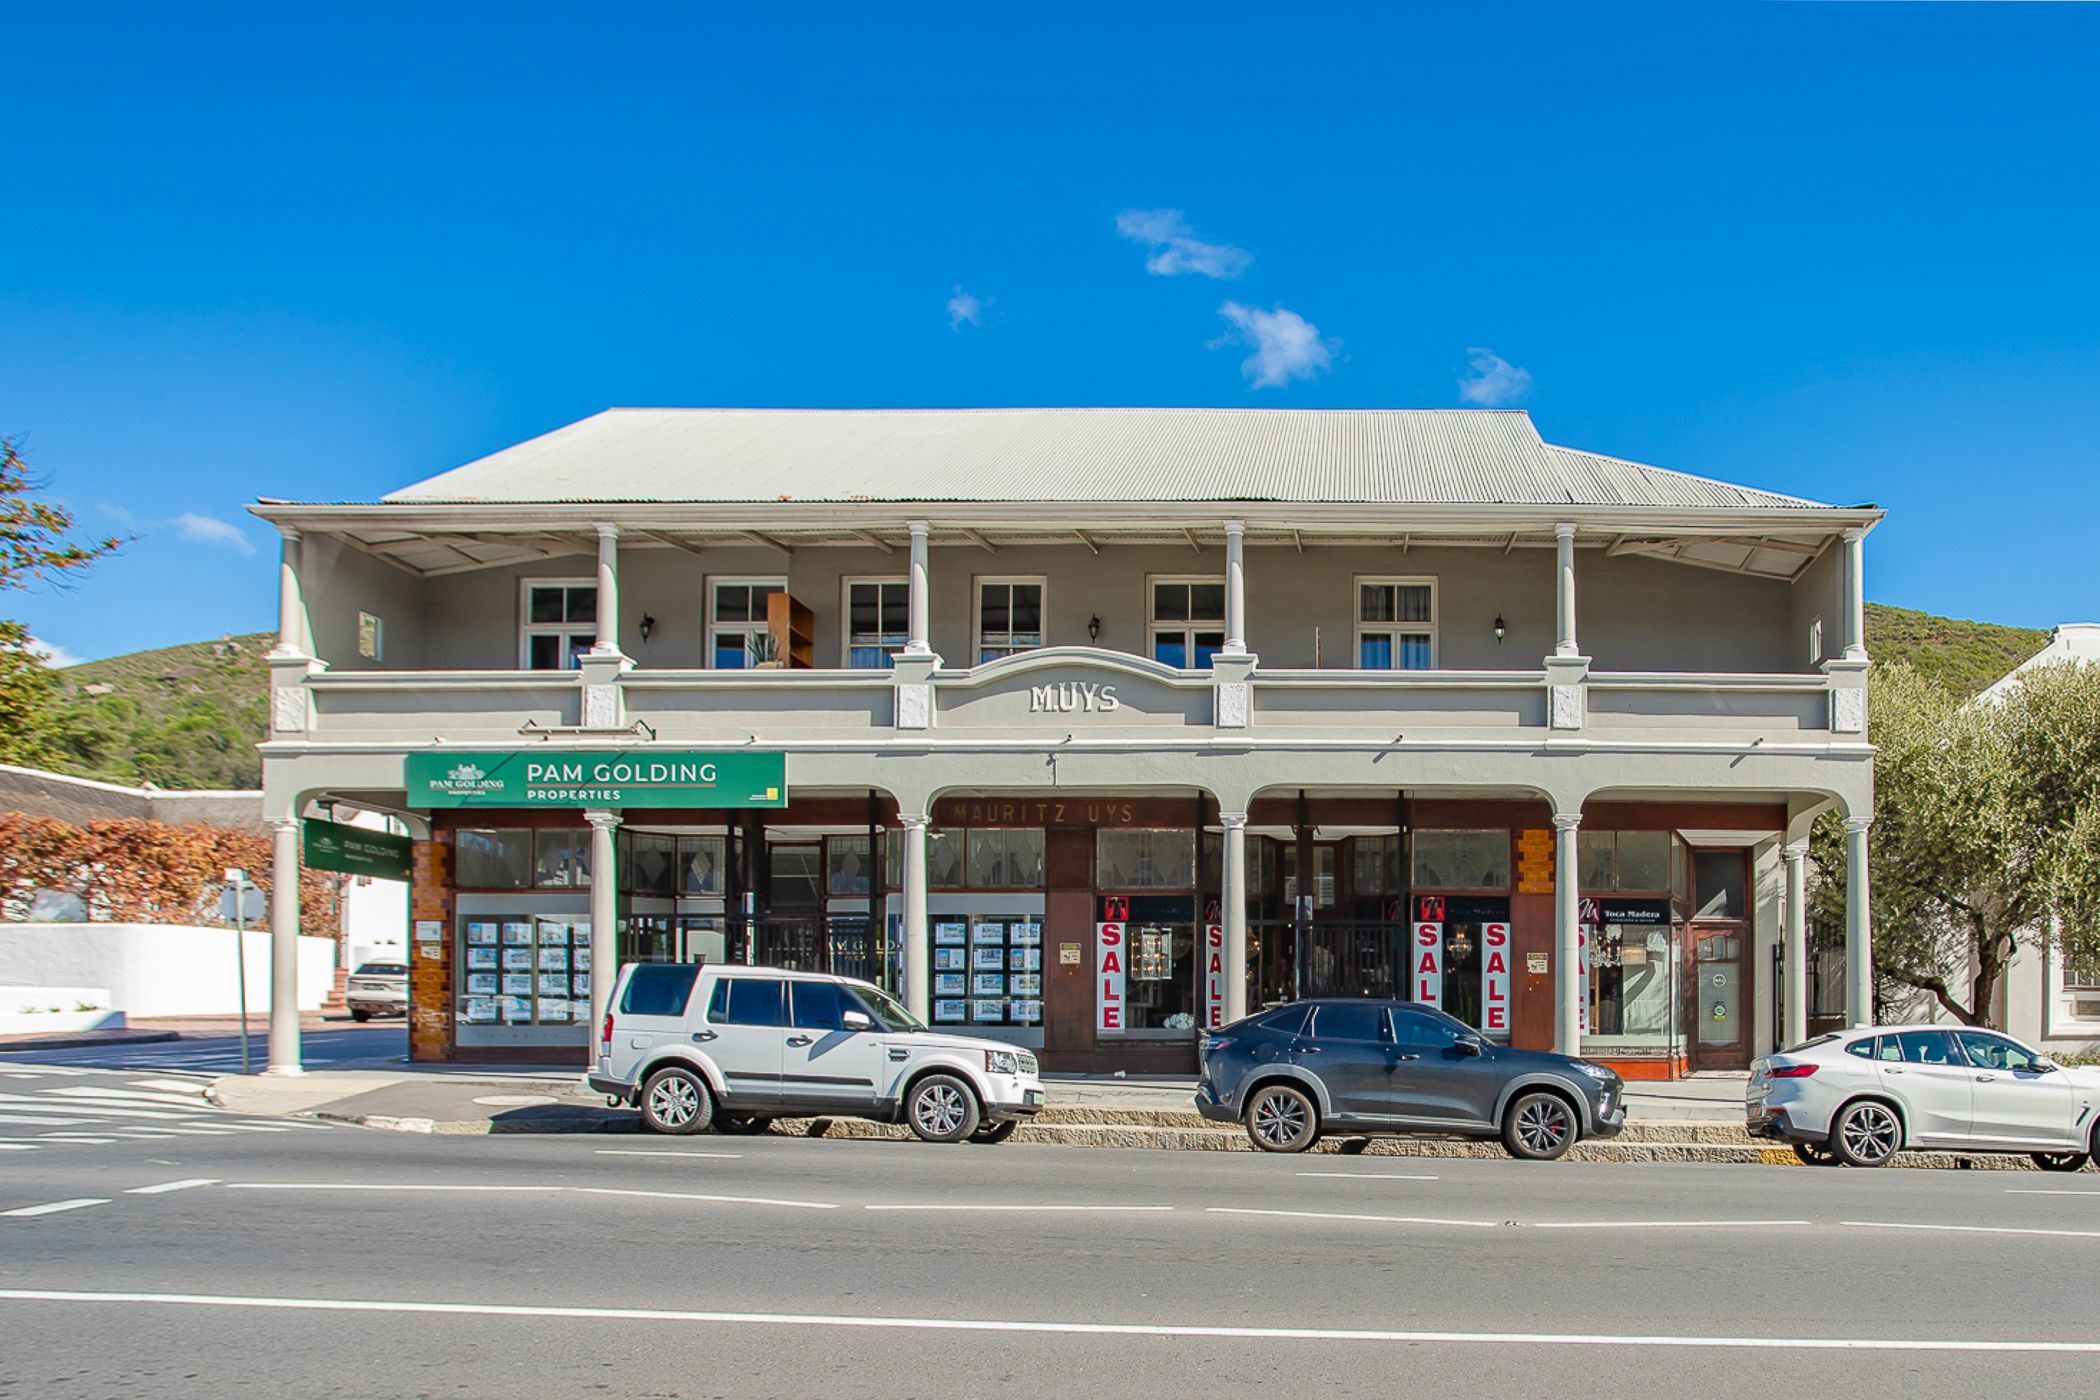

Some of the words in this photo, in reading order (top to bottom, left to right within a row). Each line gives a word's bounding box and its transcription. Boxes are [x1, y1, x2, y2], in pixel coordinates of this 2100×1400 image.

[527, 764, 582, 782] PAM
[593, 764, 717, 782] GOLDING
[429, 779, 453, 788] PAM
[455, 779, 504, 788] GOLDING
[527, 790, 621, 800] PROPERTIES
[954, 804, 1064, 822] MAURITZ
[1088, 804, 1132, 822] UYS
[1604, 910, 1625, 918] Toca
[1627, 910, 1660, 918] Madera
[1418, 924, 1438, 1001] SAL
[1101, 923, 1121, 1028] SALE
[1209, 924, 1222, 1026] SALE
[1486, 924, 1506, 1028] SALE
